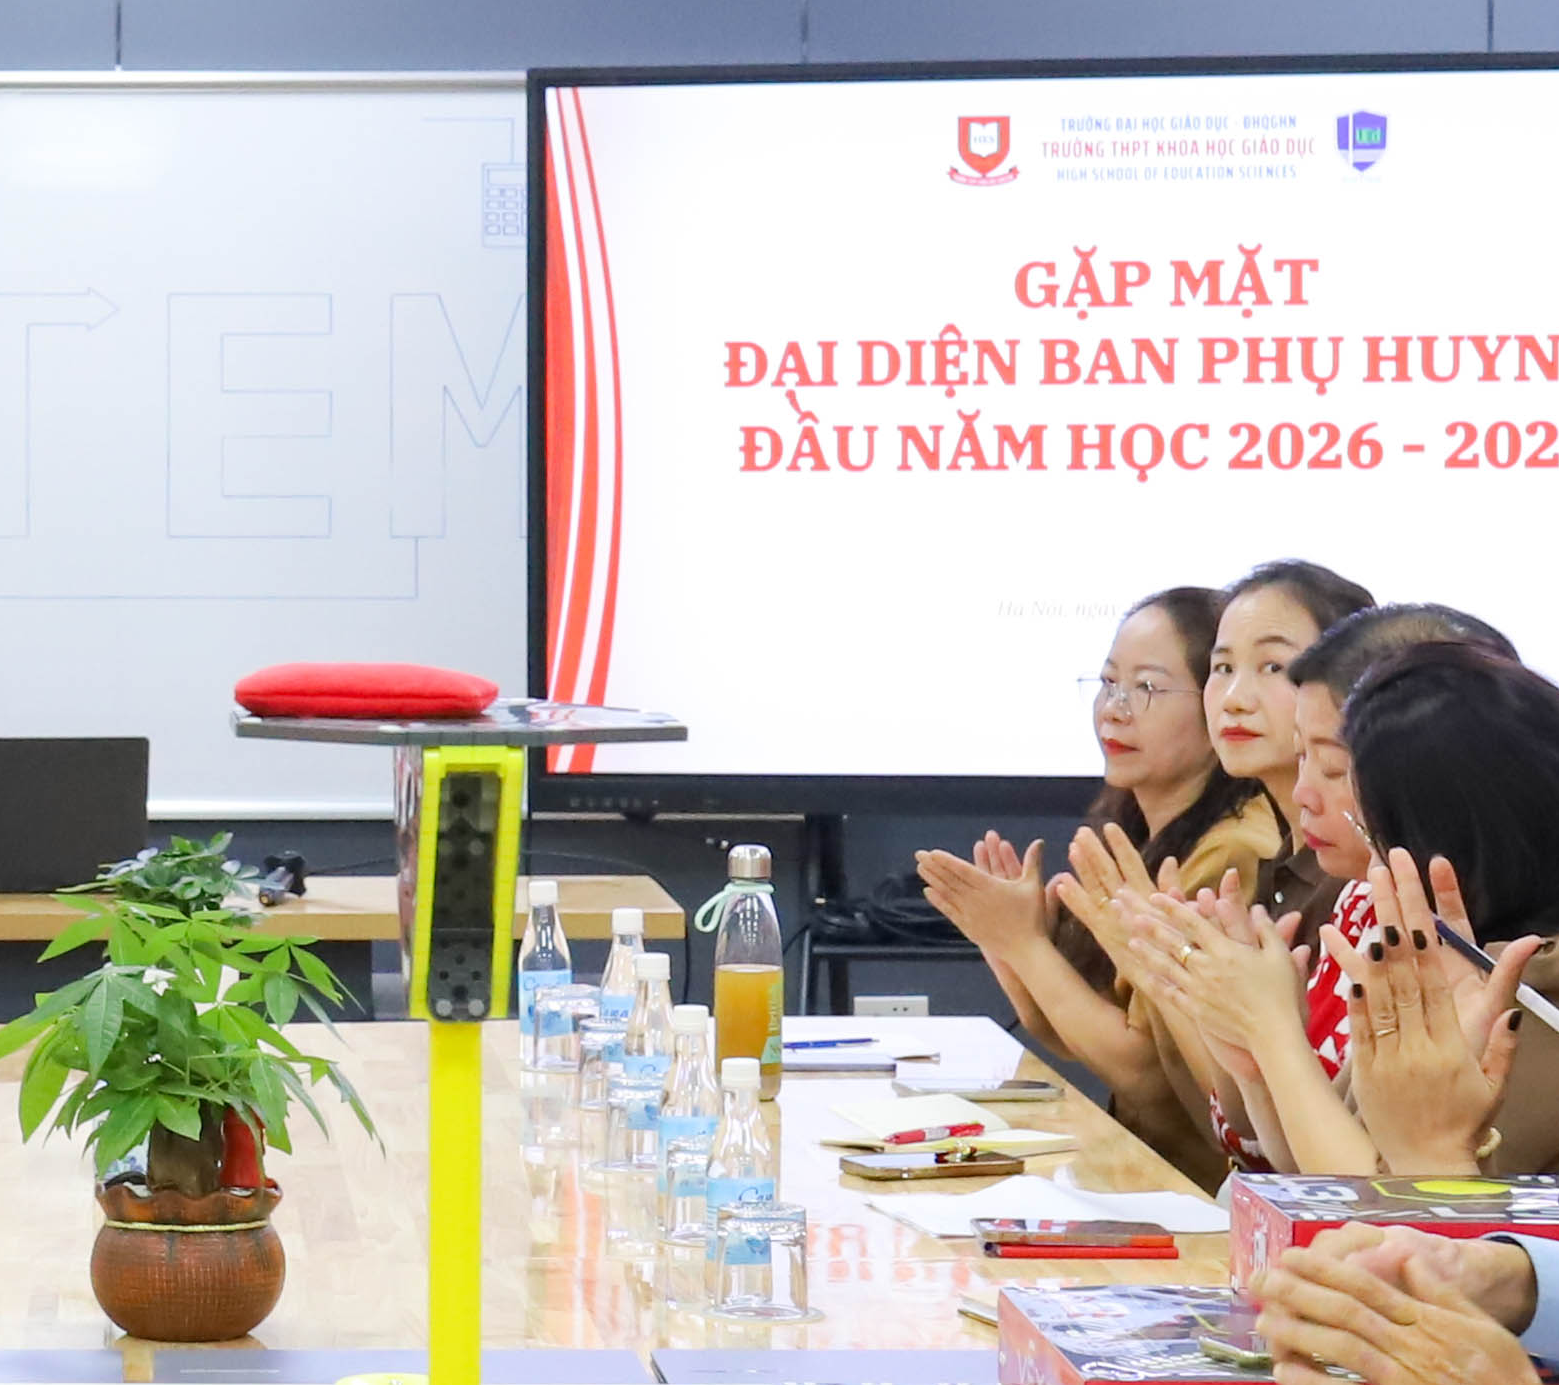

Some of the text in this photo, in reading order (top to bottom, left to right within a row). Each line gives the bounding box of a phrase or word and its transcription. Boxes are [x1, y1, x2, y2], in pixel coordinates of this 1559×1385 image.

[1042, 135, 1316, 160] TRƯỜNG THPT KHOA HỌC GIÁO DỤC
[1056, 165, 1297, 182] HIGH SCHOOL OF EDUCATION SCIENCES
[1014, 243, 1319, 320] GẶP MẶT
[724, 340, 839, 400] ĐẠI
[856, 323, 1020, 400] DIỆN
[1039, 338, 1178, 385] BAN
[1196, 336, 1344, 397] PHỤ
[738, 395, 878, 472] ĐẦU
[896, 408, 1048, 472] NĂM
[1066, 424, 1210, 482] HỌC
[1227, 422, 1385, 471] 2026
[1402, 444, 1426, 453] -
